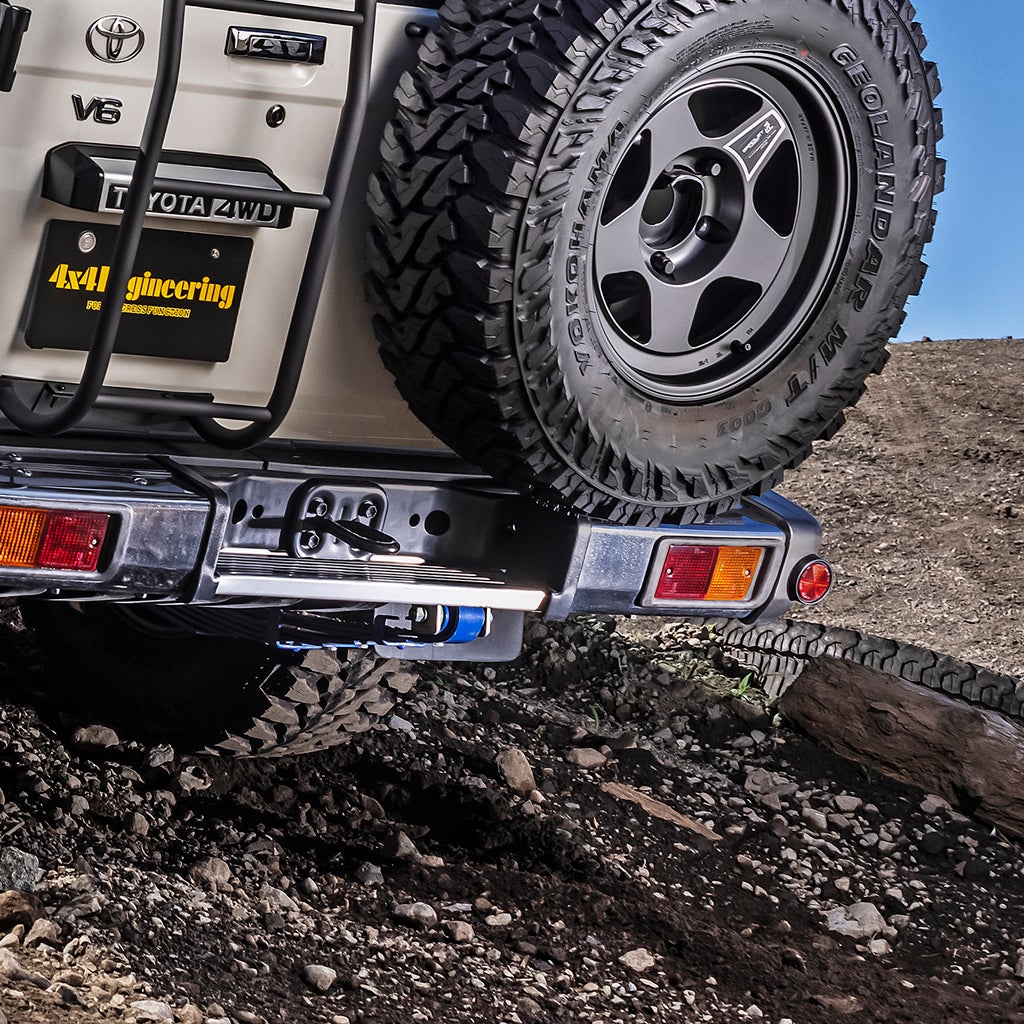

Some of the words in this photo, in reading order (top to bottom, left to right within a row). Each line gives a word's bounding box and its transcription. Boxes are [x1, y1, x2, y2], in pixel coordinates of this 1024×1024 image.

[71, 94, 123, 125] V6
[113, 186, 207, 216] TYOTA
[213, 199, 277, 224] 4WD
[830, 43, 896, 312] GEOLANDAR
[566, 118, 625, 376] YOKOHAMA
[48, 263, 236, 309] 4x4gineering
[785, 320, 849, 407] M/T
